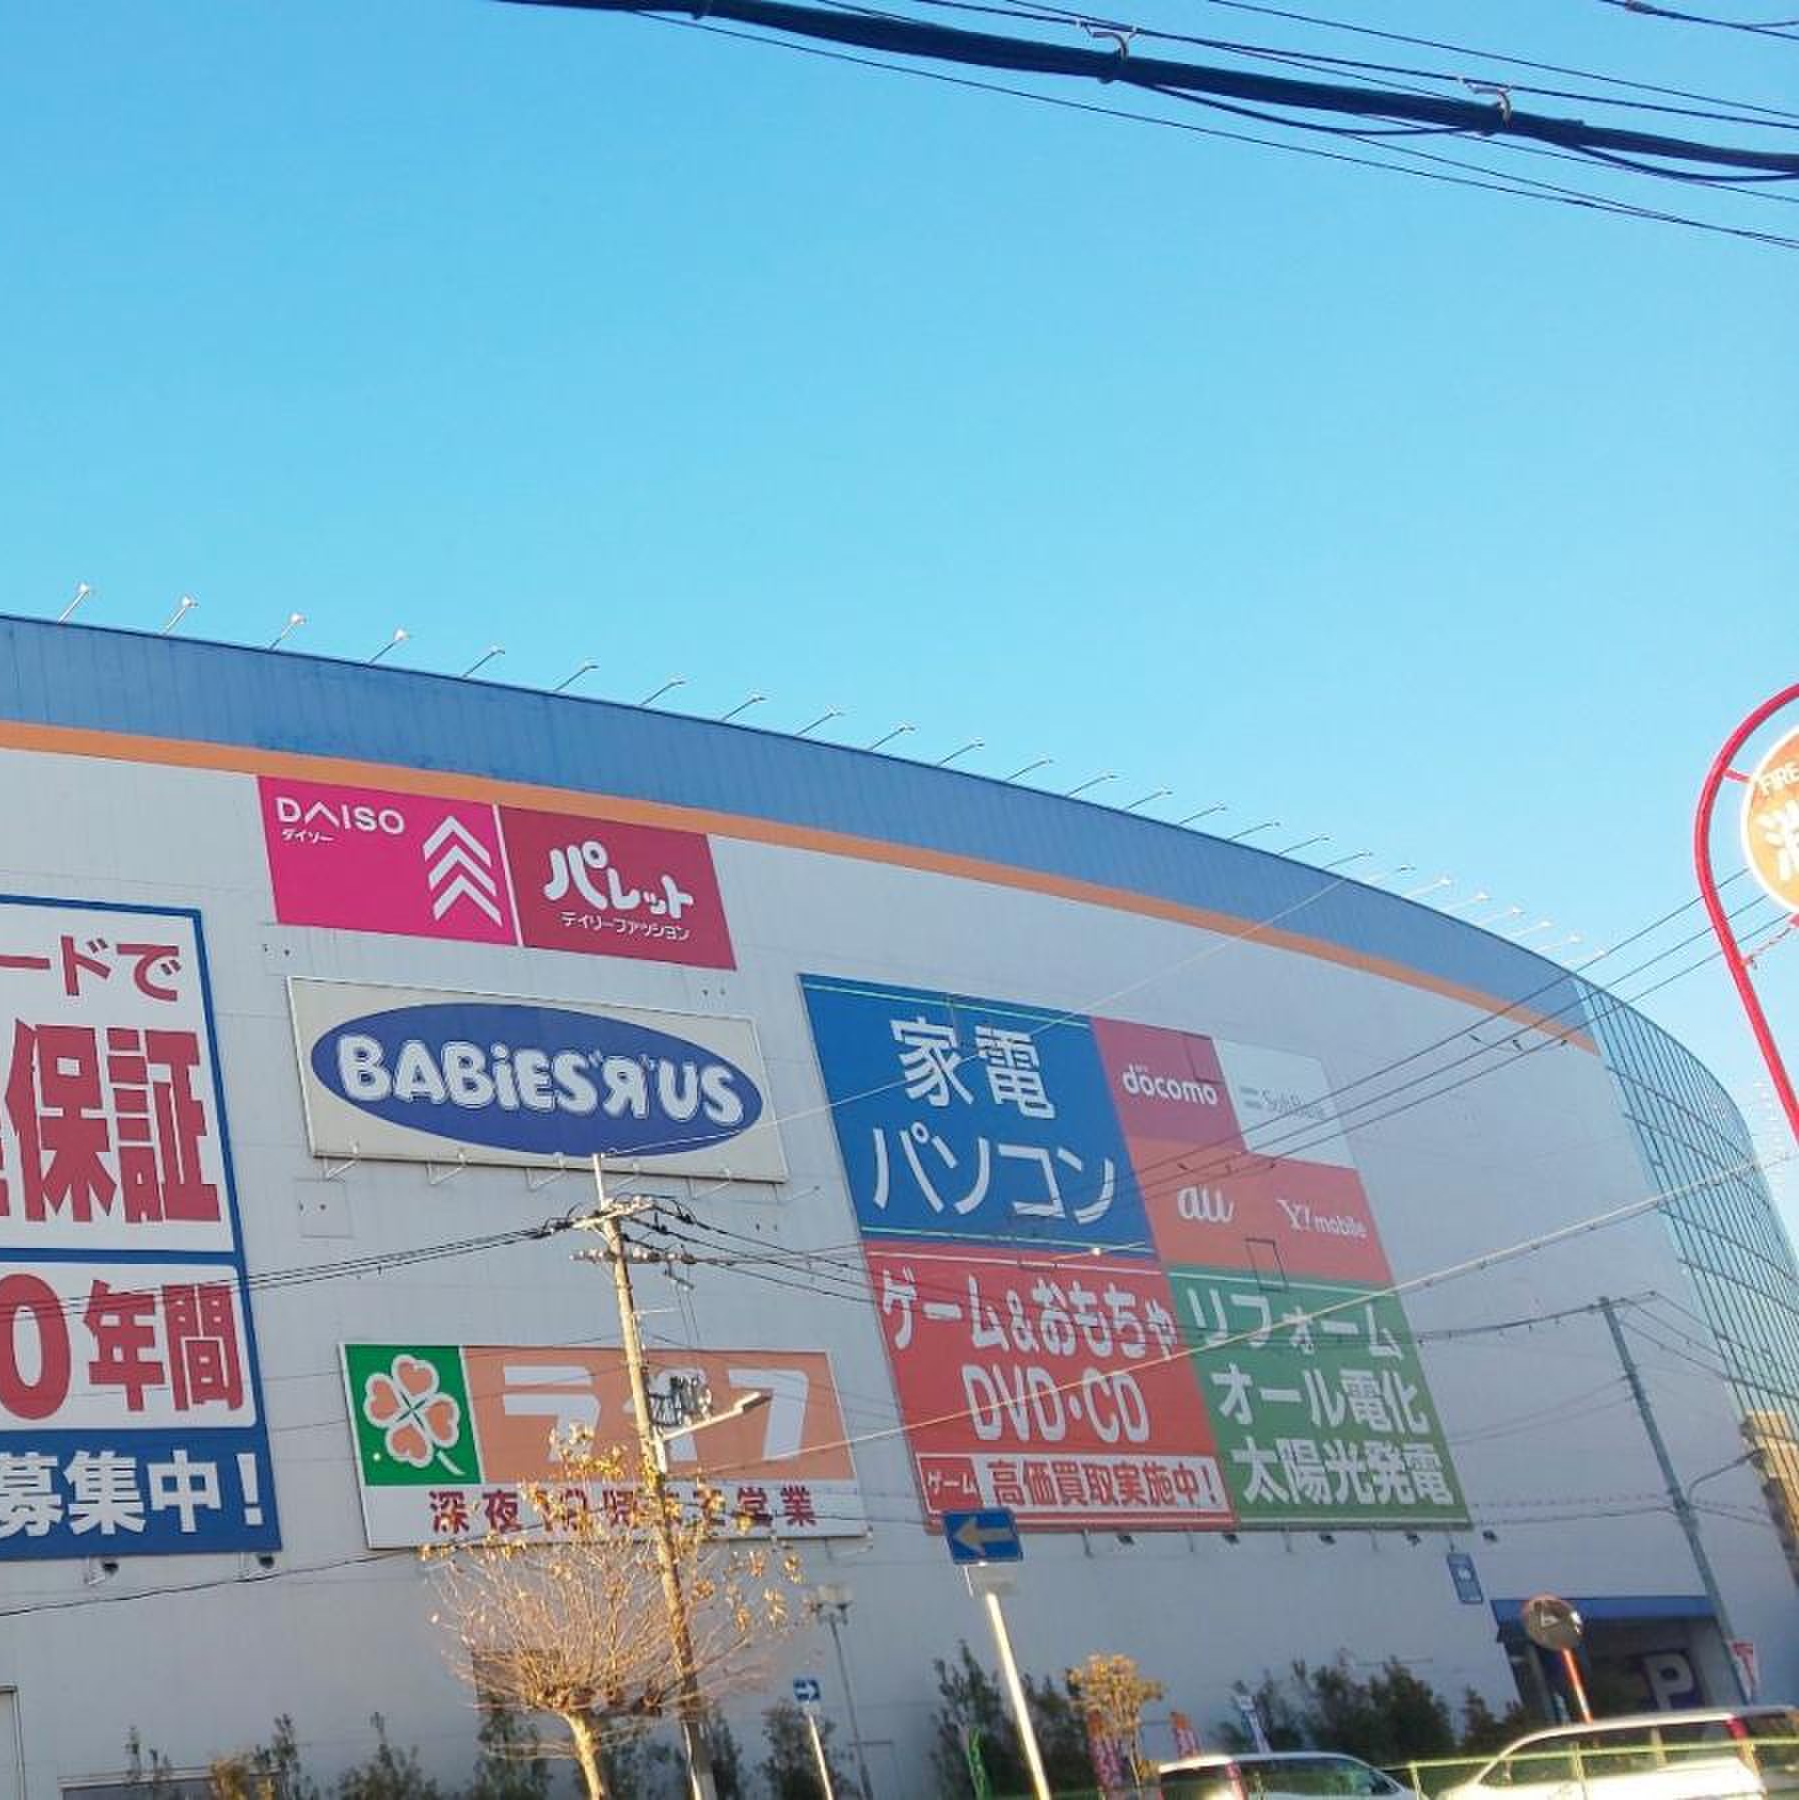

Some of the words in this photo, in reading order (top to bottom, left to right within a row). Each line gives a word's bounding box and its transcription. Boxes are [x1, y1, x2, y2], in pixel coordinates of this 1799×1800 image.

[275, 796, 405, 835] DAISO
[282, 828, 334, 844] ダイソー
[543, 840, 694, 919] パレット
[891, 1015, 1056, 1121] 家電
[1122, 1063, 1217, 1104] docomo
[872, 1121, 1116, 1225] パソコン
[1178, 1186, 1234, 1225] au
[1187, 1288, 1404, 1360] リフォーム
[1211, 1362, 1431, 1434] オール電化
[926, 1469, 978, 1497] ゲーム
[1230, 1436, 1454, 1504] 太陽光発電
